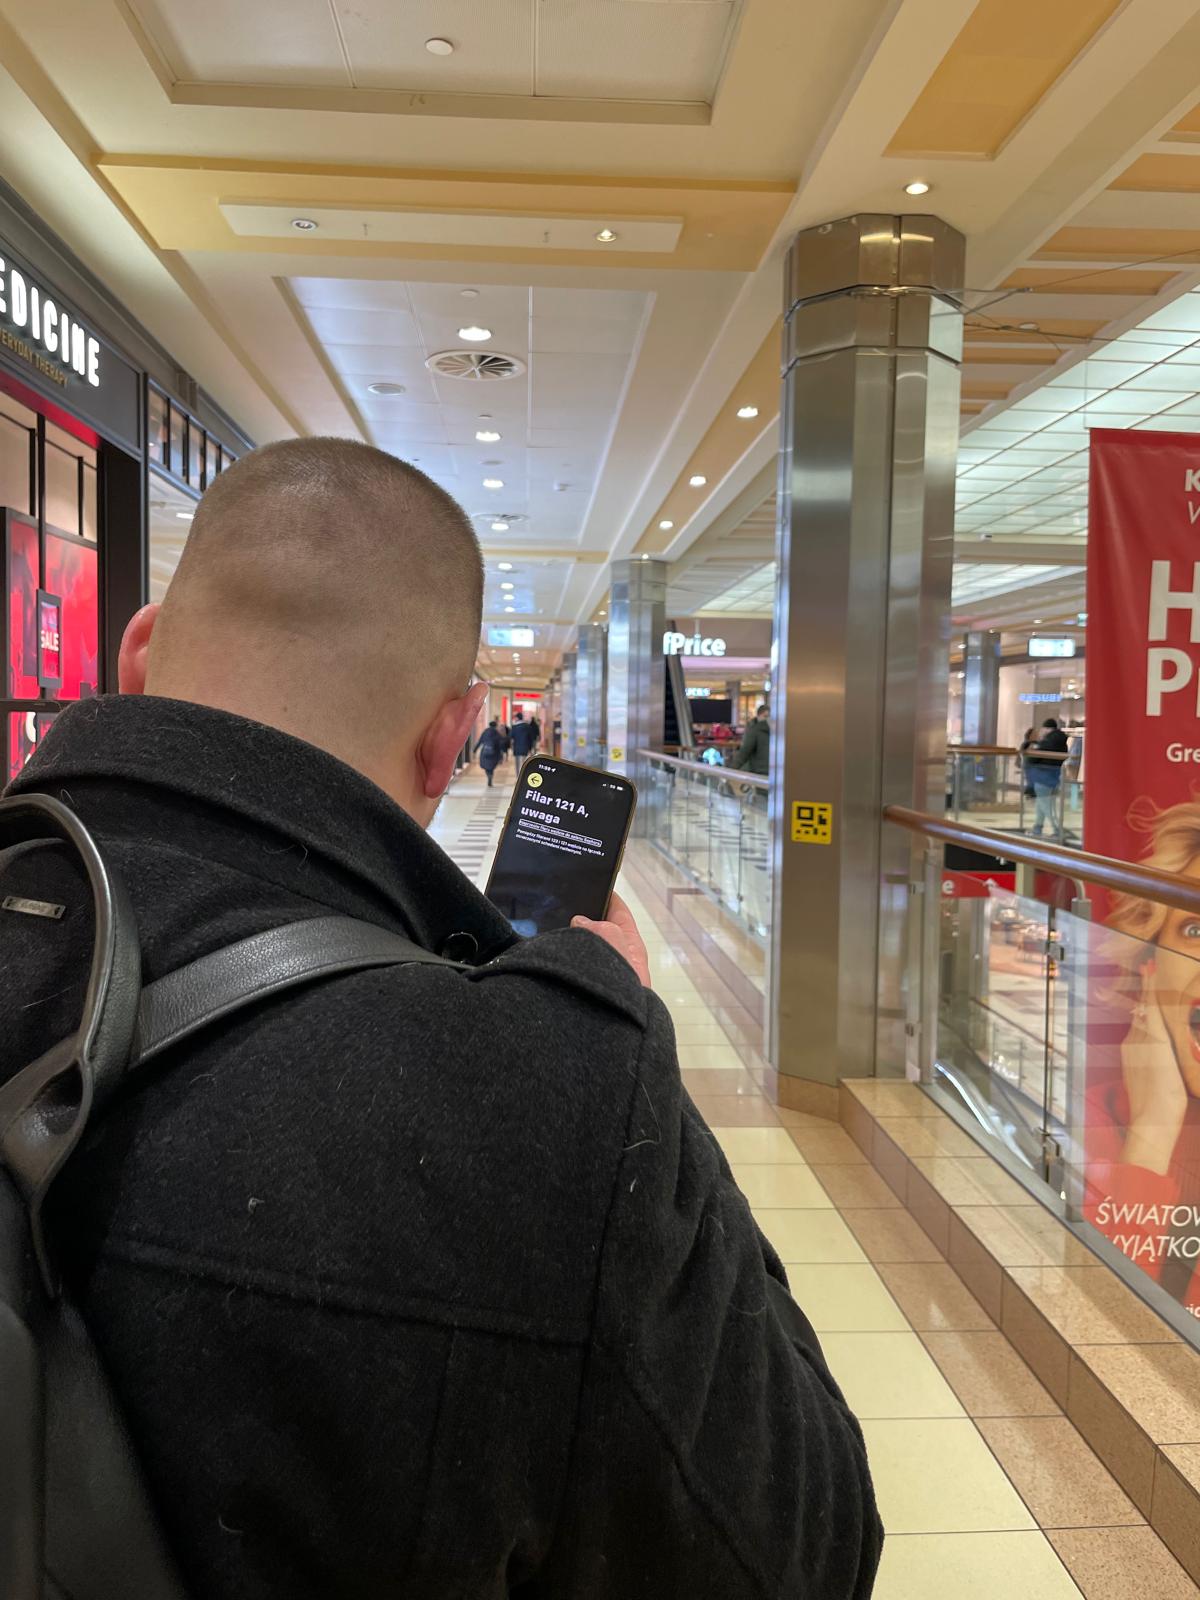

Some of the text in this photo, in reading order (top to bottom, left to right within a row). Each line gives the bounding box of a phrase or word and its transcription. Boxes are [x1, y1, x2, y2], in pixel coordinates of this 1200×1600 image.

[41, 630, 59, 651] SALE
[1146, 647, 1200, 718] P
[521, 806, 560, 824] uwaga
[526, 790, 589, 818] Filar 121 A,
[1105, 1234, 1200, 1262] YJĄTKO
